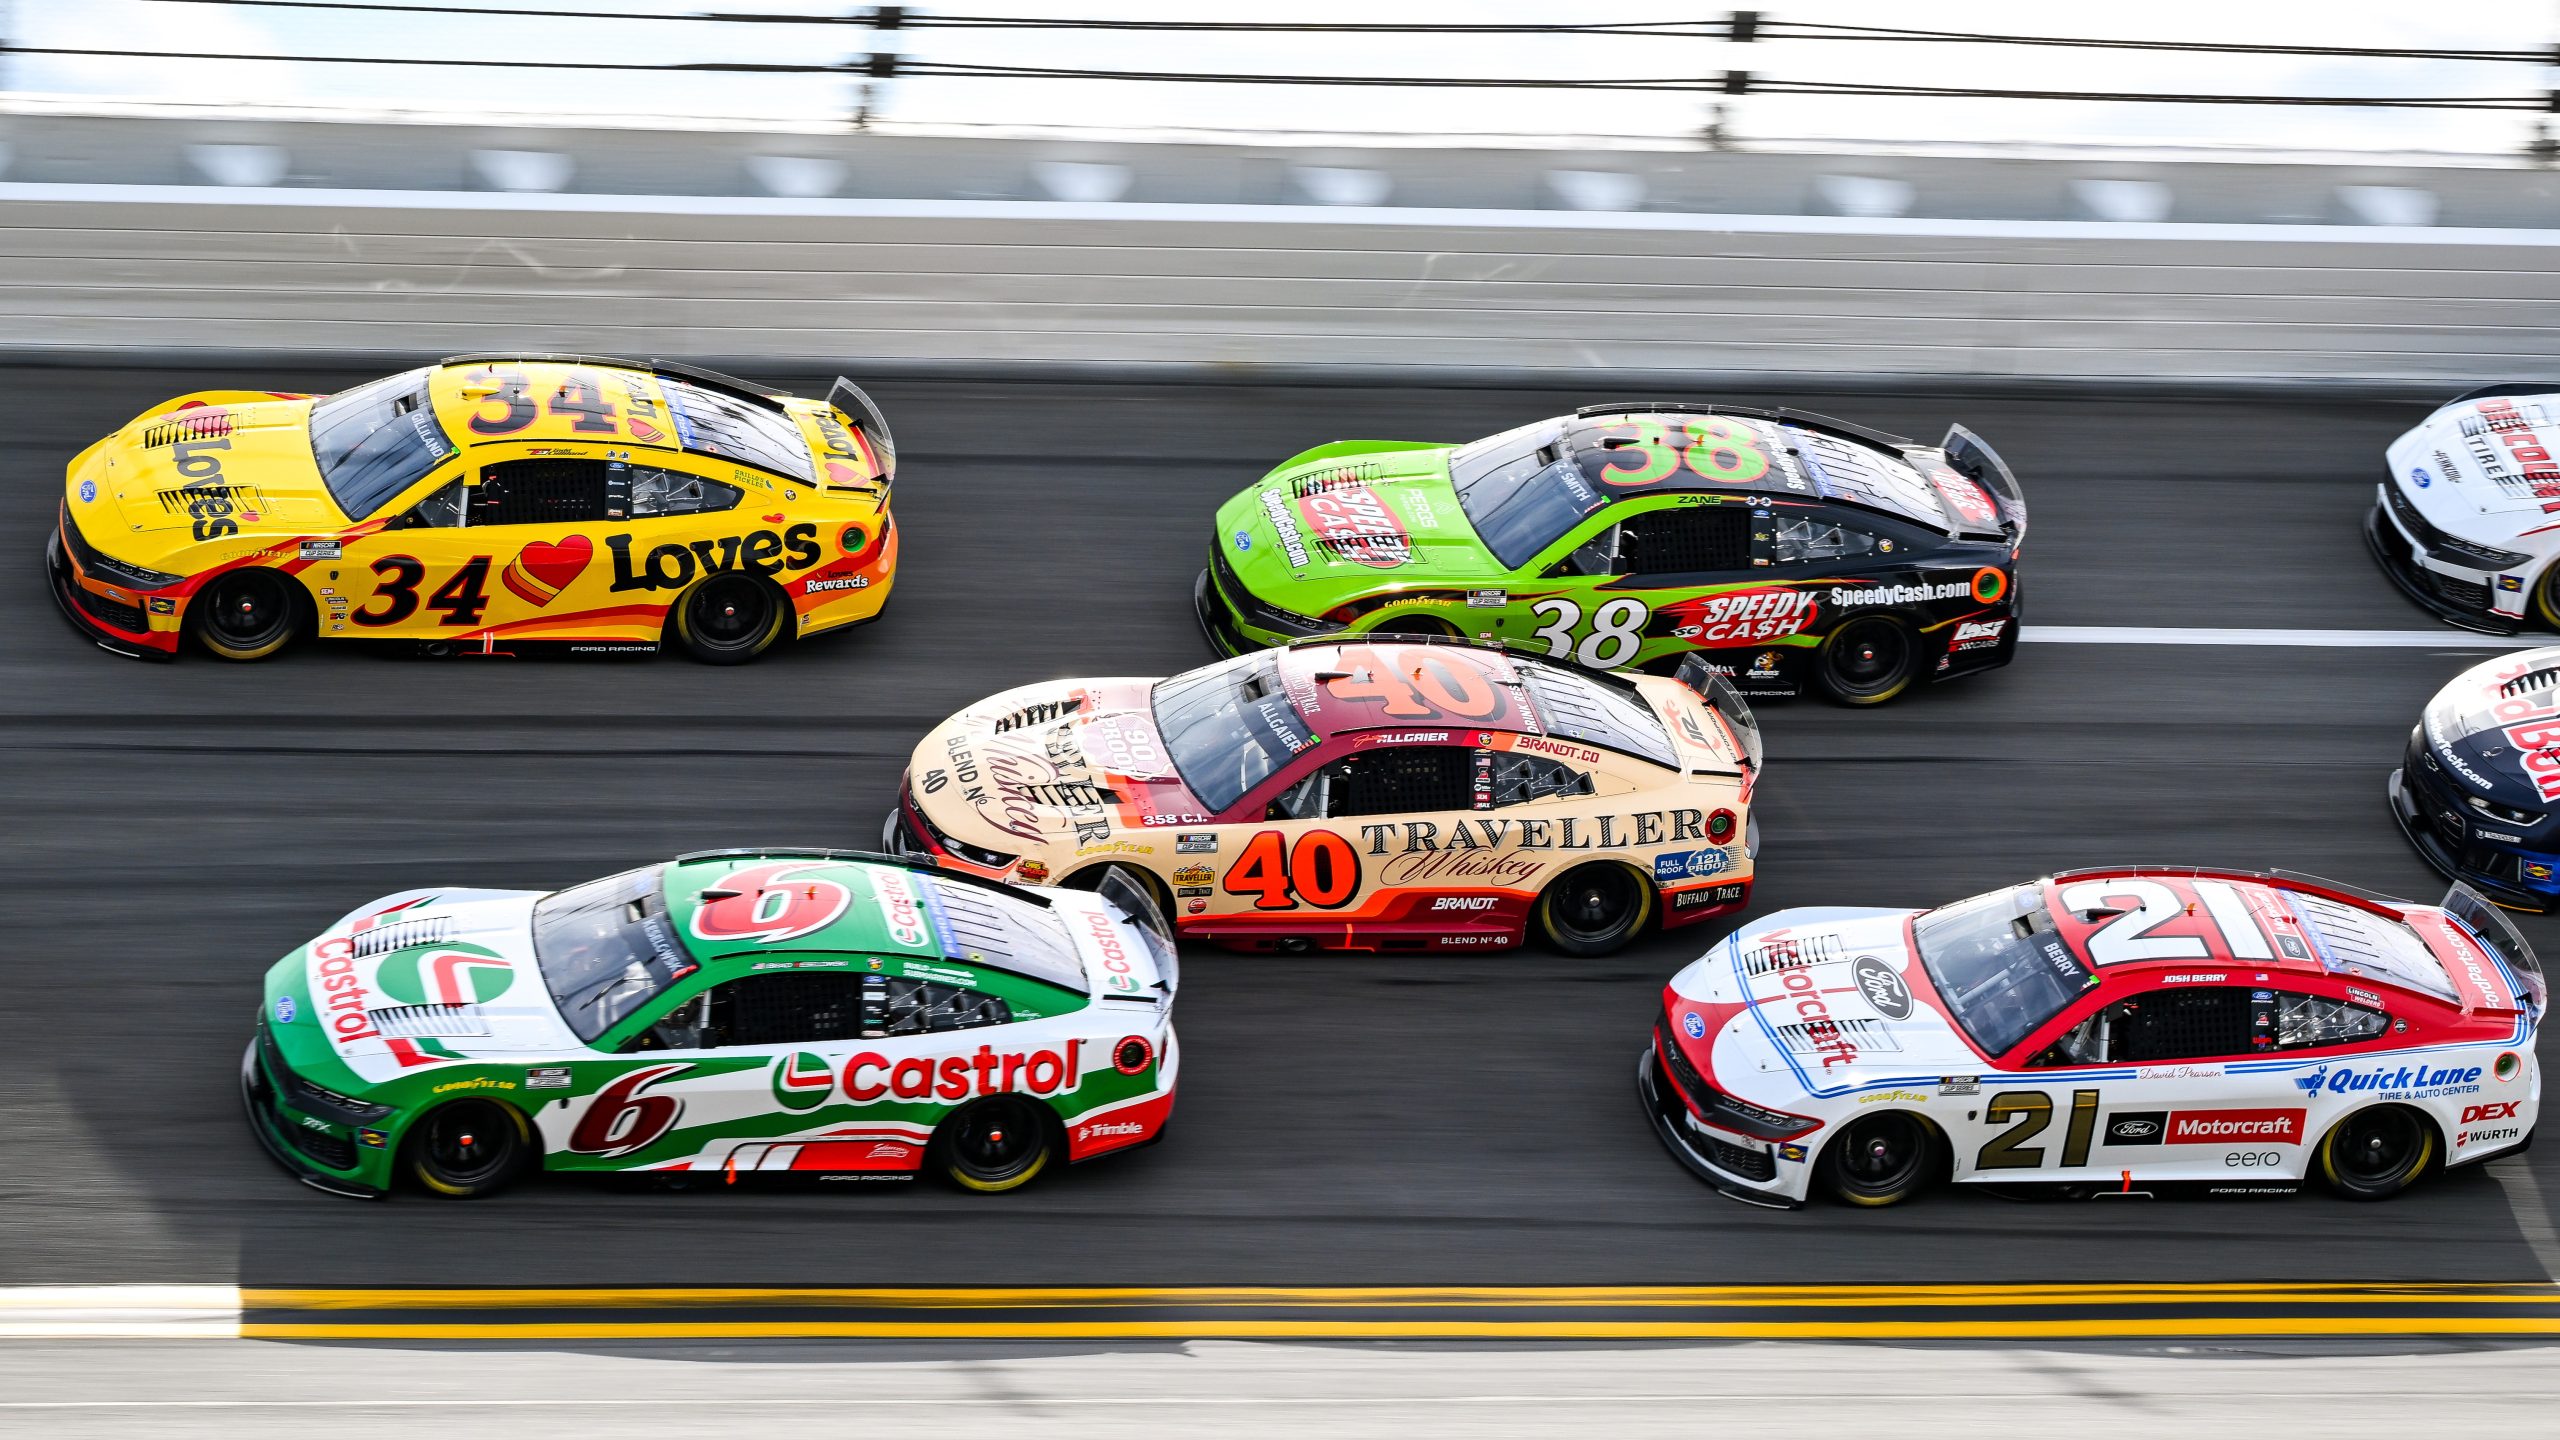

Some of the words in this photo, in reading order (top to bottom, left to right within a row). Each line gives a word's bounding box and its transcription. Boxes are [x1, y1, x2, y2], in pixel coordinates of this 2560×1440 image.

[464, 366, 621, 437] 34
[411, 413, 445, 458] GILLILAND
[1601, 417, 1769, 487] 38
[2467, 437, 2504, 475] TIRE
[1560, 472, 1592, 502] SMITH
[1676, 495, 1722, 505] ZANE
[1260, 487, 1311, 569] SpeedyCash.com
[351, 554, 490, 628] 34
[805, 574, 870, 593] Rewards
[1831, 582, 1971, 607] SpeedyCash.com
[1384, 596, 1453, 608] GOODYEAR
[1702, 591, 1818, 624] SPEEDY
[1530, 597, 1650, 669] 38
[1705, 617, 1804, 641] CA$H
[1328, 648, 1504, 720] 40
[1745, 668, 1780, 677] Aaron's
[1258, 702, 1303, 752] ALLGAIER
[1520, 704, 1541, 734] DRINK
[1123, 729, 1159, 761] 90
[1517, 736, 1600, 763] BRANDT.CO
[947, 736, 979, 783] BLEND
[922, 769, 949, 795] 40
[1143, 815, 1177, 825] 358
[1182, 813, 1208, 824] C.I.
[1361, 808, 1706, 856] TRAVELLER
[1222, 829, 1361, 910] 40
[1380, 846, 1546, 886] Whiskey
[1656, 866, 1684, 875] PROOF
[1660, 859, 1680, 868] FULL
[1687, 861, 1729, 873] PROOF
[1696, 852, 1721, 865] 121
[1175, 873, 1212, 882] TRAVELLER
[690, 863, 853, 944] 6
[1431, 896, 1496, 911] BRANDT
[1676, 891, 1709, 908] BUFFALO
[1716, 887, 1740, 901] TRACE
[2058, 880, 2280, 969] 21
[1080, 910, 1131, 973] Castrol
[1496, 936, 1508, 944] 40
[2043, 942, 2080, 977] BERRY
[2439, 923, 2504, 1009] FordParts.com
[315, 938, 380, 1043] Castrol
[1859, 968, 1903, 1008] Ford
[2161, 975, 2190, 983] JOSH
[2191, 974, 2228, 983] BERRY
[2347, 987, 2378, 999] LINCOLN
[2354, 996, 2381, 1007] WELDERS
[1684, 1014, 1702, 1037] Ford
[842, 1039, 1080, 1100] Castrol
[2139, 1067, 2175, 1080] David
[2179, 1065, 2222, 1079] Pearson
[2329, 1066, 2403, 1094] Quick
[2412, 1065, 2482, 1087] Lane
[1858, 1090, 1929, 1103] GOODYEAR
[2378, 1091, 2402, 1100] TIRE
[2405, 1091, 2411, 1099] &
[2413, 1088, 2441, 1099] AUTO
[2442, 1084, 2480, 1096] CENTER
[569, 1063, 698, 1158] 6
[2460, 1101, 2522, 1125] DEX
[1092, 1122, 1143, 1137] Trimble
[1974, 1089, 2101, 1171] 21
[2119, 1121, 2151, 1135] Ford
[2177, 1117, 2291, 1136] Motorcraft
[2470, 1127, 2518, 1142] WÜRTH
[2225, 1152, 2281, 1167] eero
